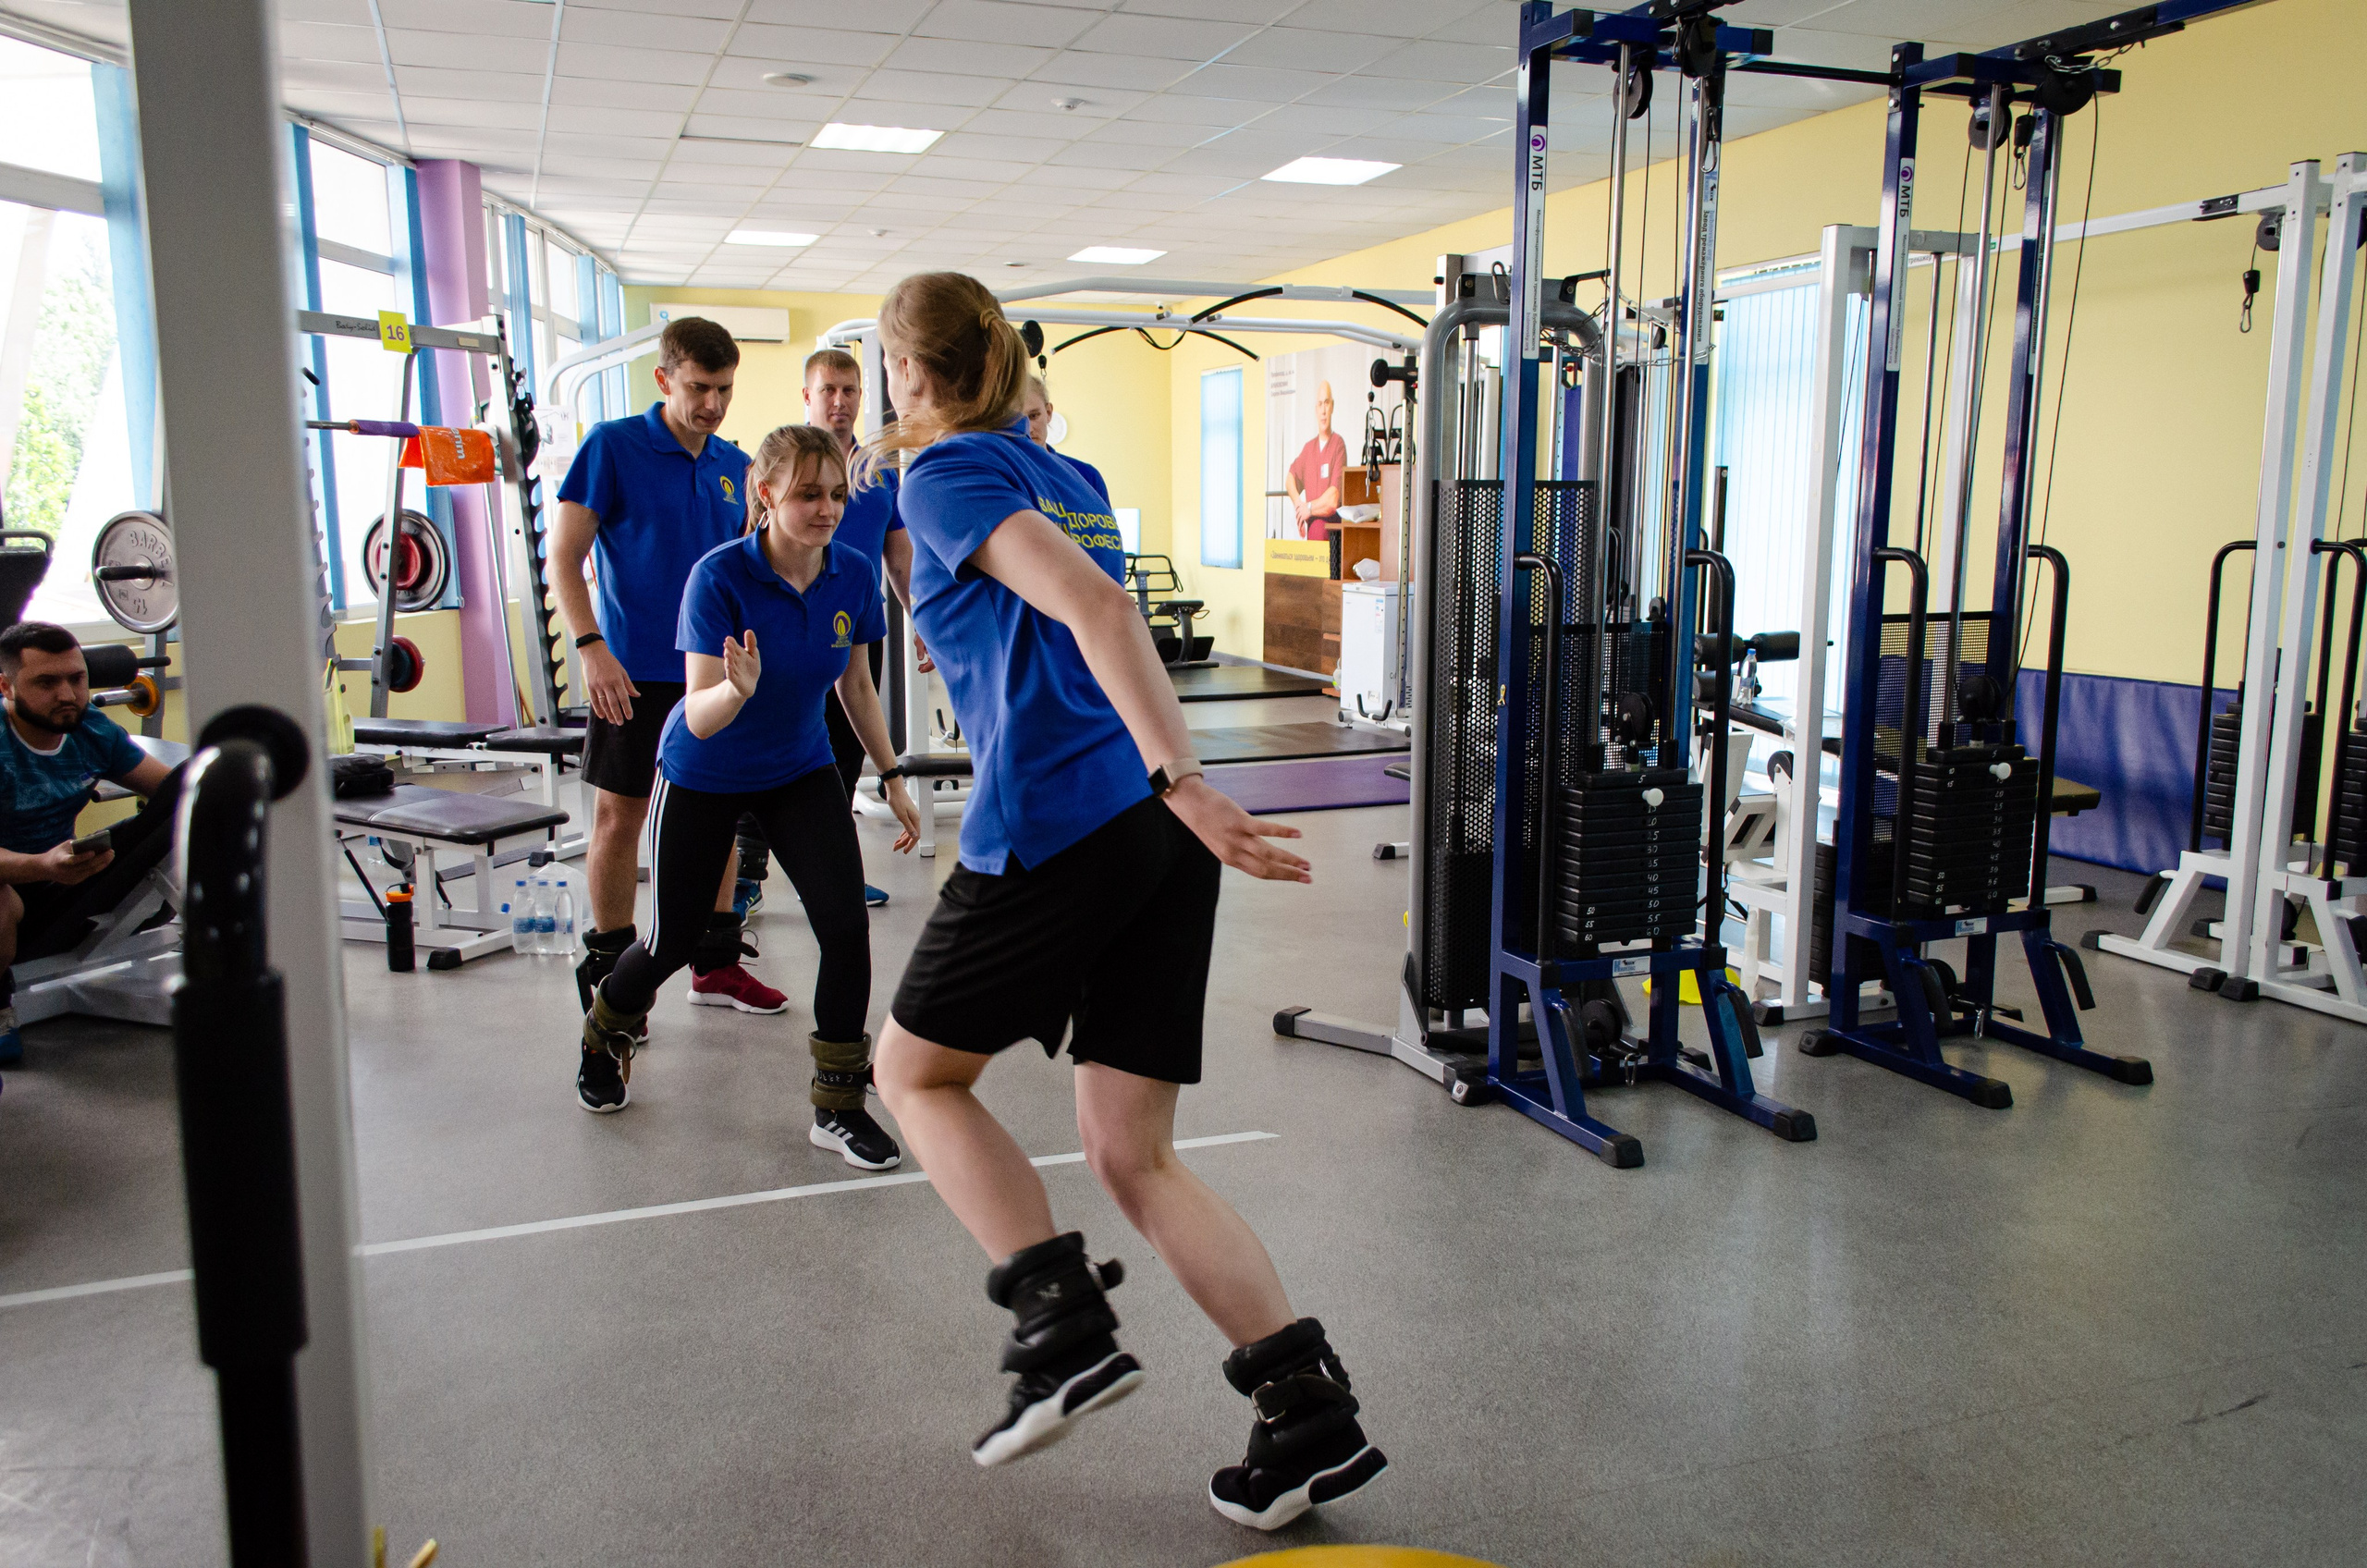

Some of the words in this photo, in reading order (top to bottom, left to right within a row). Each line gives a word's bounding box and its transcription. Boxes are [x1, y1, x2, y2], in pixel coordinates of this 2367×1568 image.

[1531, 155, 1544, 190] МТБ
[1899, 185, 1911, 218] МТБ
[1701, 210, 1710, 232] Завод
[1697, 288, 1705, 342] оборудования
[386, 324, 405, 341] 16
[1638, 775, 1646, 783] 5
[1993, 802, 2004, 811] 25
[1647, 845, 1658, 853] 30
[1647, 874, 1659, 882] 40
[1648, 900, 1660, 909] 50
[1586, 907, 1596, 915] 50
[1647, 914, 1661, 923] 55
[1646, 927, 1660, 937] 60
